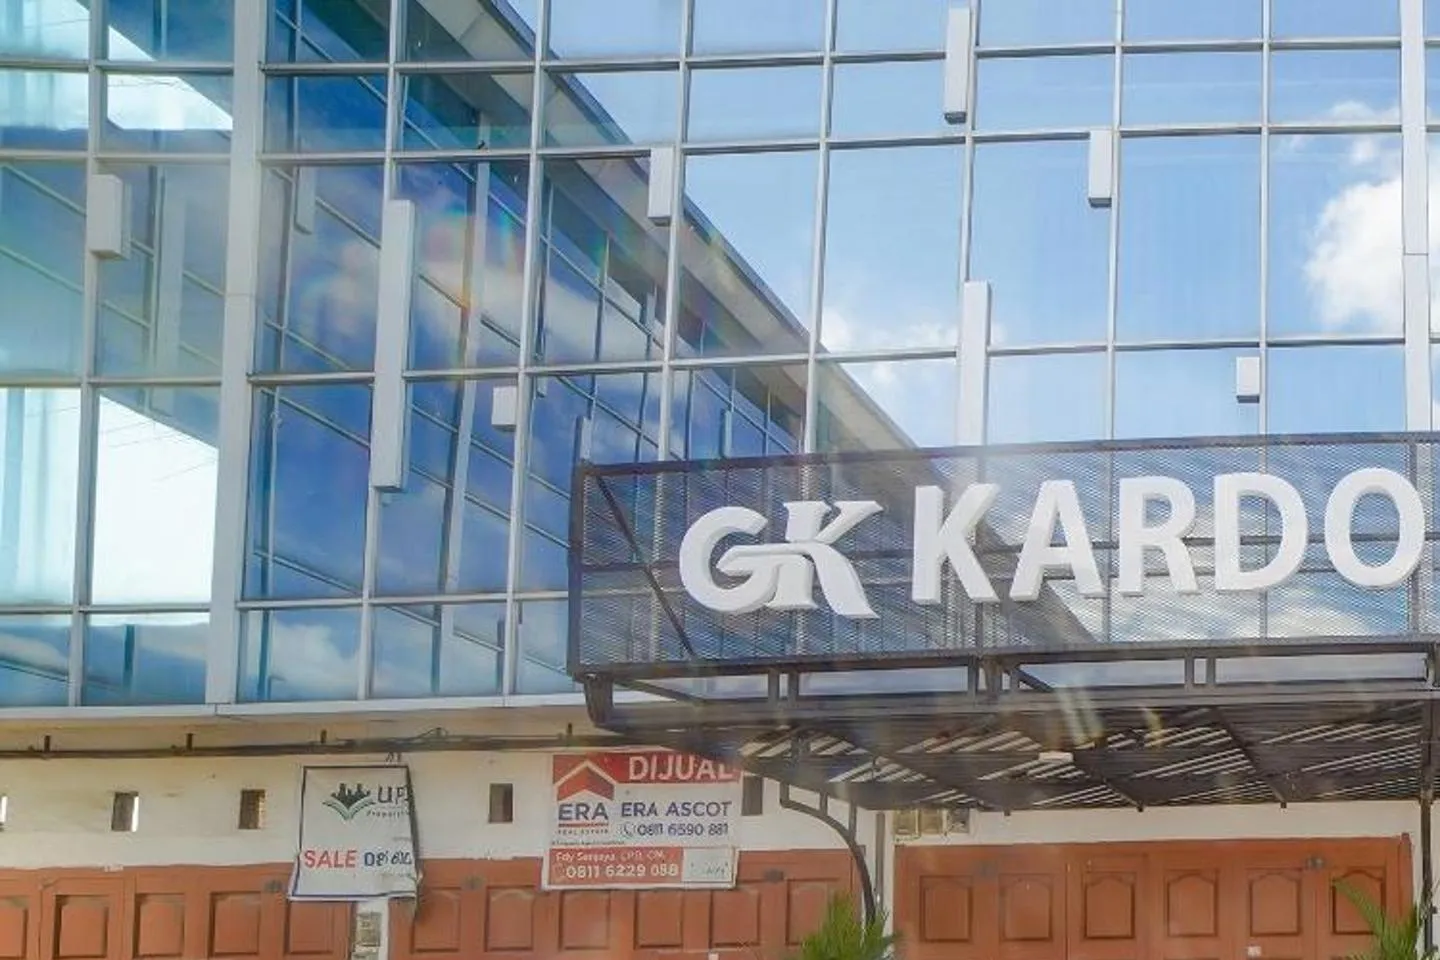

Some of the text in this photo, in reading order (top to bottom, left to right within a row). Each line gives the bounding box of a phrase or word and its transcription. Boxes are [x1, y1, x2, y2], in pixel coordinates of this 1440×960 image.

[679, 500, 884, 619] GK
[628, 754, 733, 781] DIJUAL
[558, 803, 609, 821] ERA
[621, 800, 733, 818] ERA ASCOT
[668, 822, 704, 836] 6590
[303, 849, 357, 868] SALE
[566, 864, 600, 879] 0811
[605, 863, 646, 878] 6229
